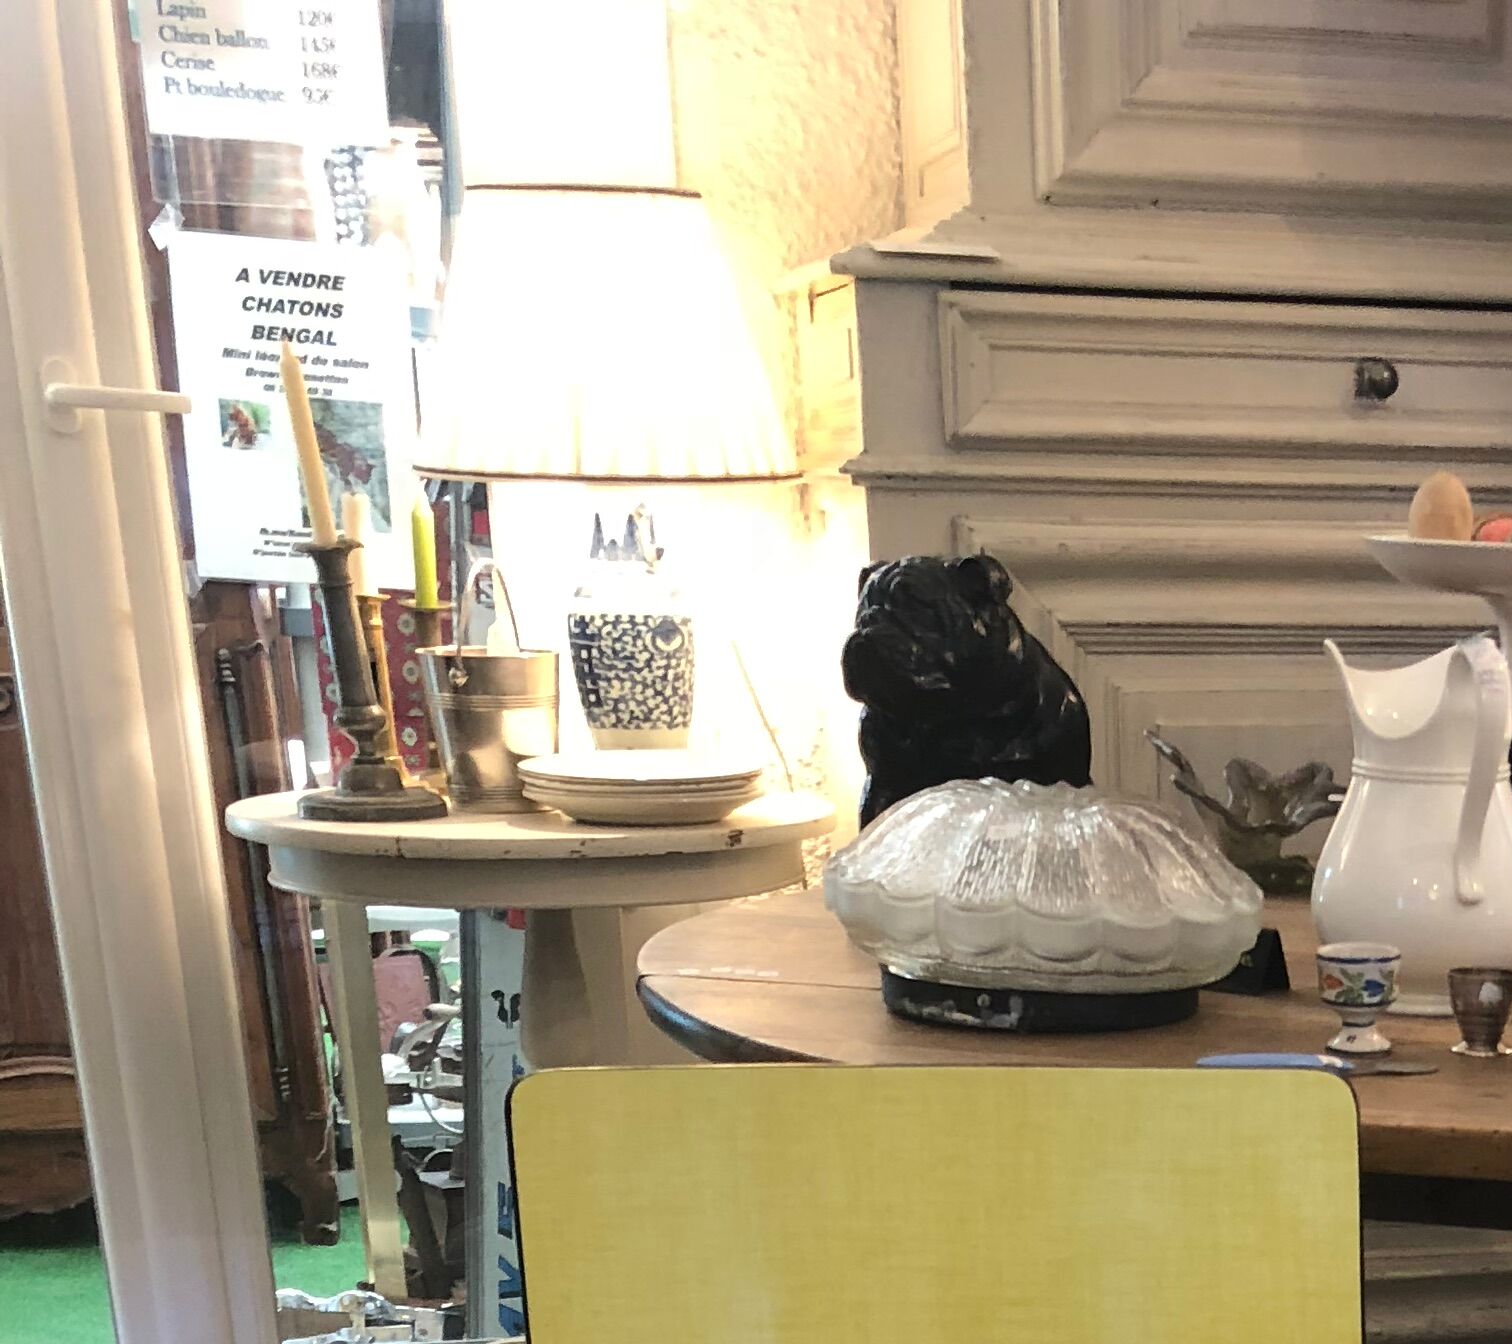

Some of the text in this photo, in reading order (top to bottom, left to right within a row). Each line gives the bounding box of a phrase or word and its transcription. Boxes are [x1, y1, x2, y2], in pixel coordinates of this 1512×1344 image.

[158, 24, 211, 45] Chien
[235, 267, 346, 291] A VENDRE
[241, 296, 344, 319] CHATONS
[251, 325, 337, 346] BENGAL
